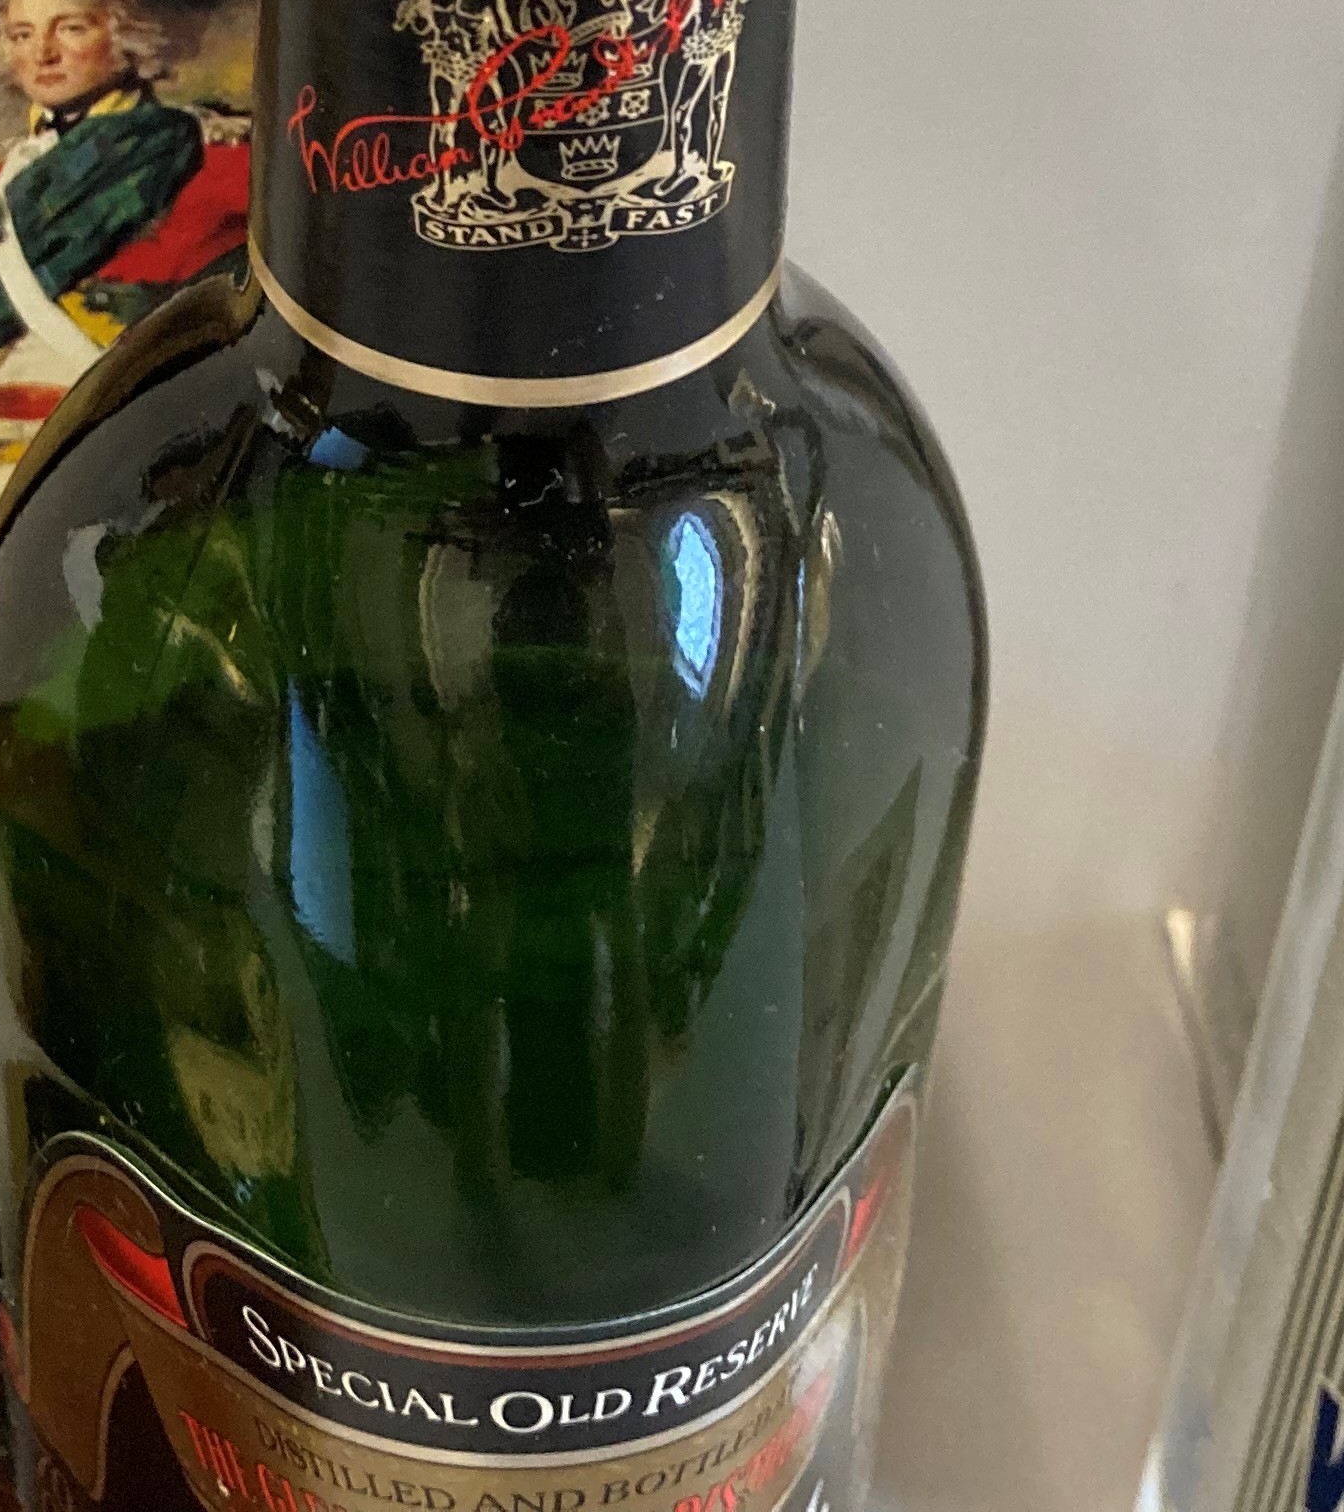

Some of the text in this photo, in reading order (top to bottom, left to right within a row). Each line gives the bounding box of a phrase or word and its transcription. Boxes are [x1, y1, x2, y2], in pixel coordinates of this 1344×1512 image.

[423, 197, 720, 244] STAND FAST
[242, 1262, 820, 1434] SPECIAL OLD RESERVE
[254, 1415, 456, 1511] DISTILLED
